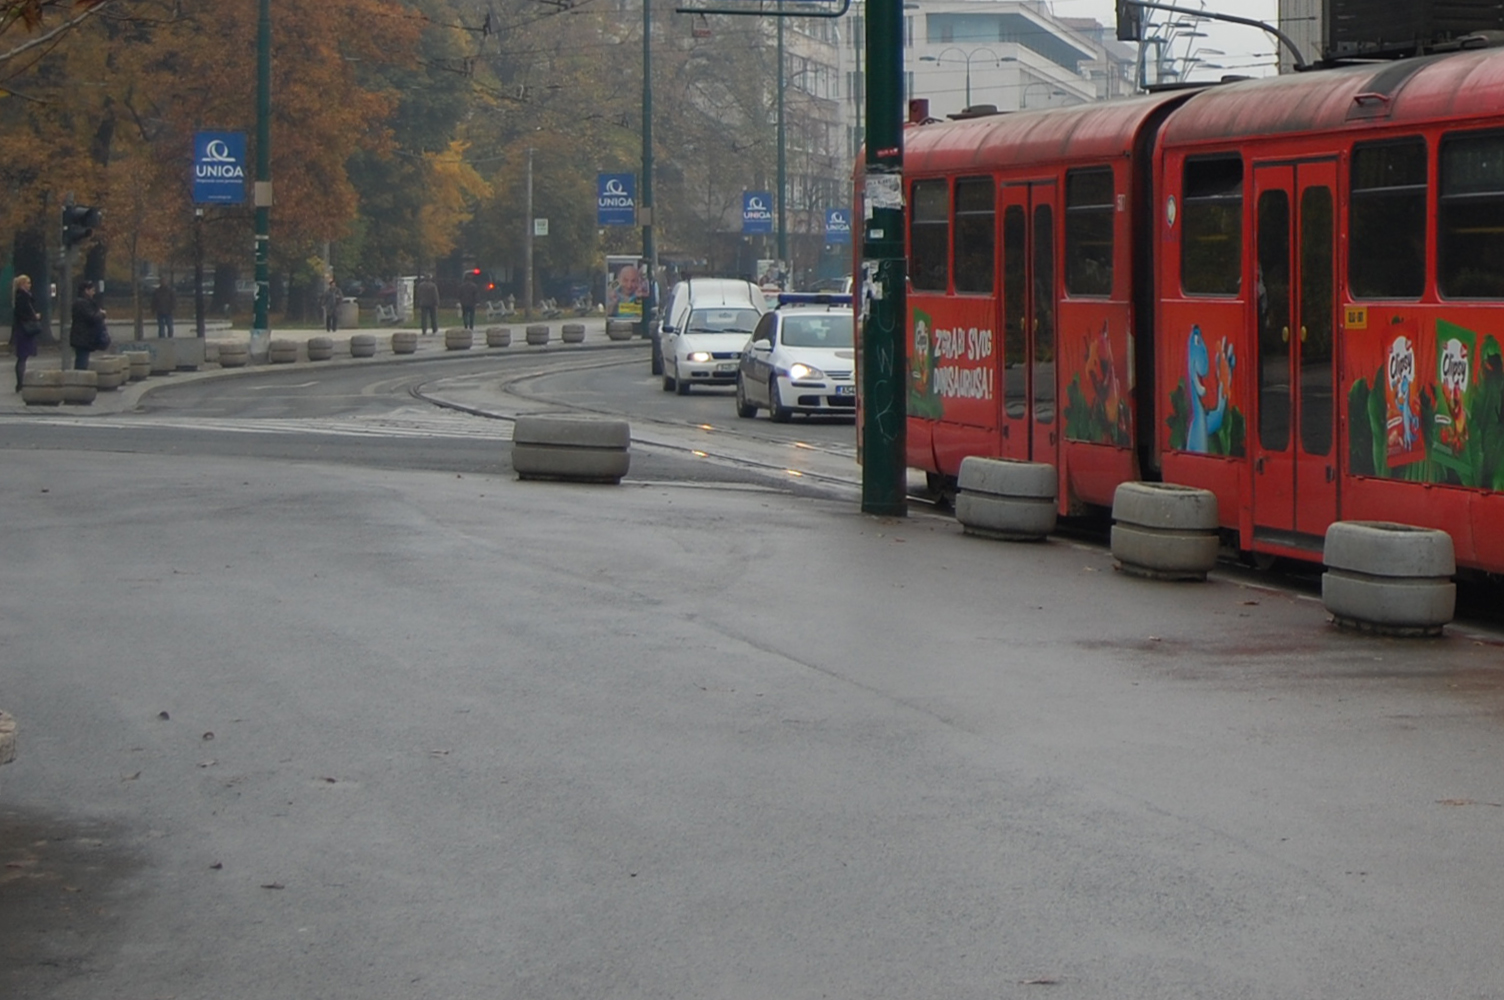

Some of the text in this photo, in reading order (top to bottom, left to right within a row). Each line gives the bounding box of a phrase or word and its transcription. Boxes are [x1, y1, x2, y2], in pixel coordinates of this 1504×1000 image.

[196, 165, 244, 178] UNIQA
[598, 197, 634, 207] UNIQA
[743, 211, 772, 220] UNIQA
